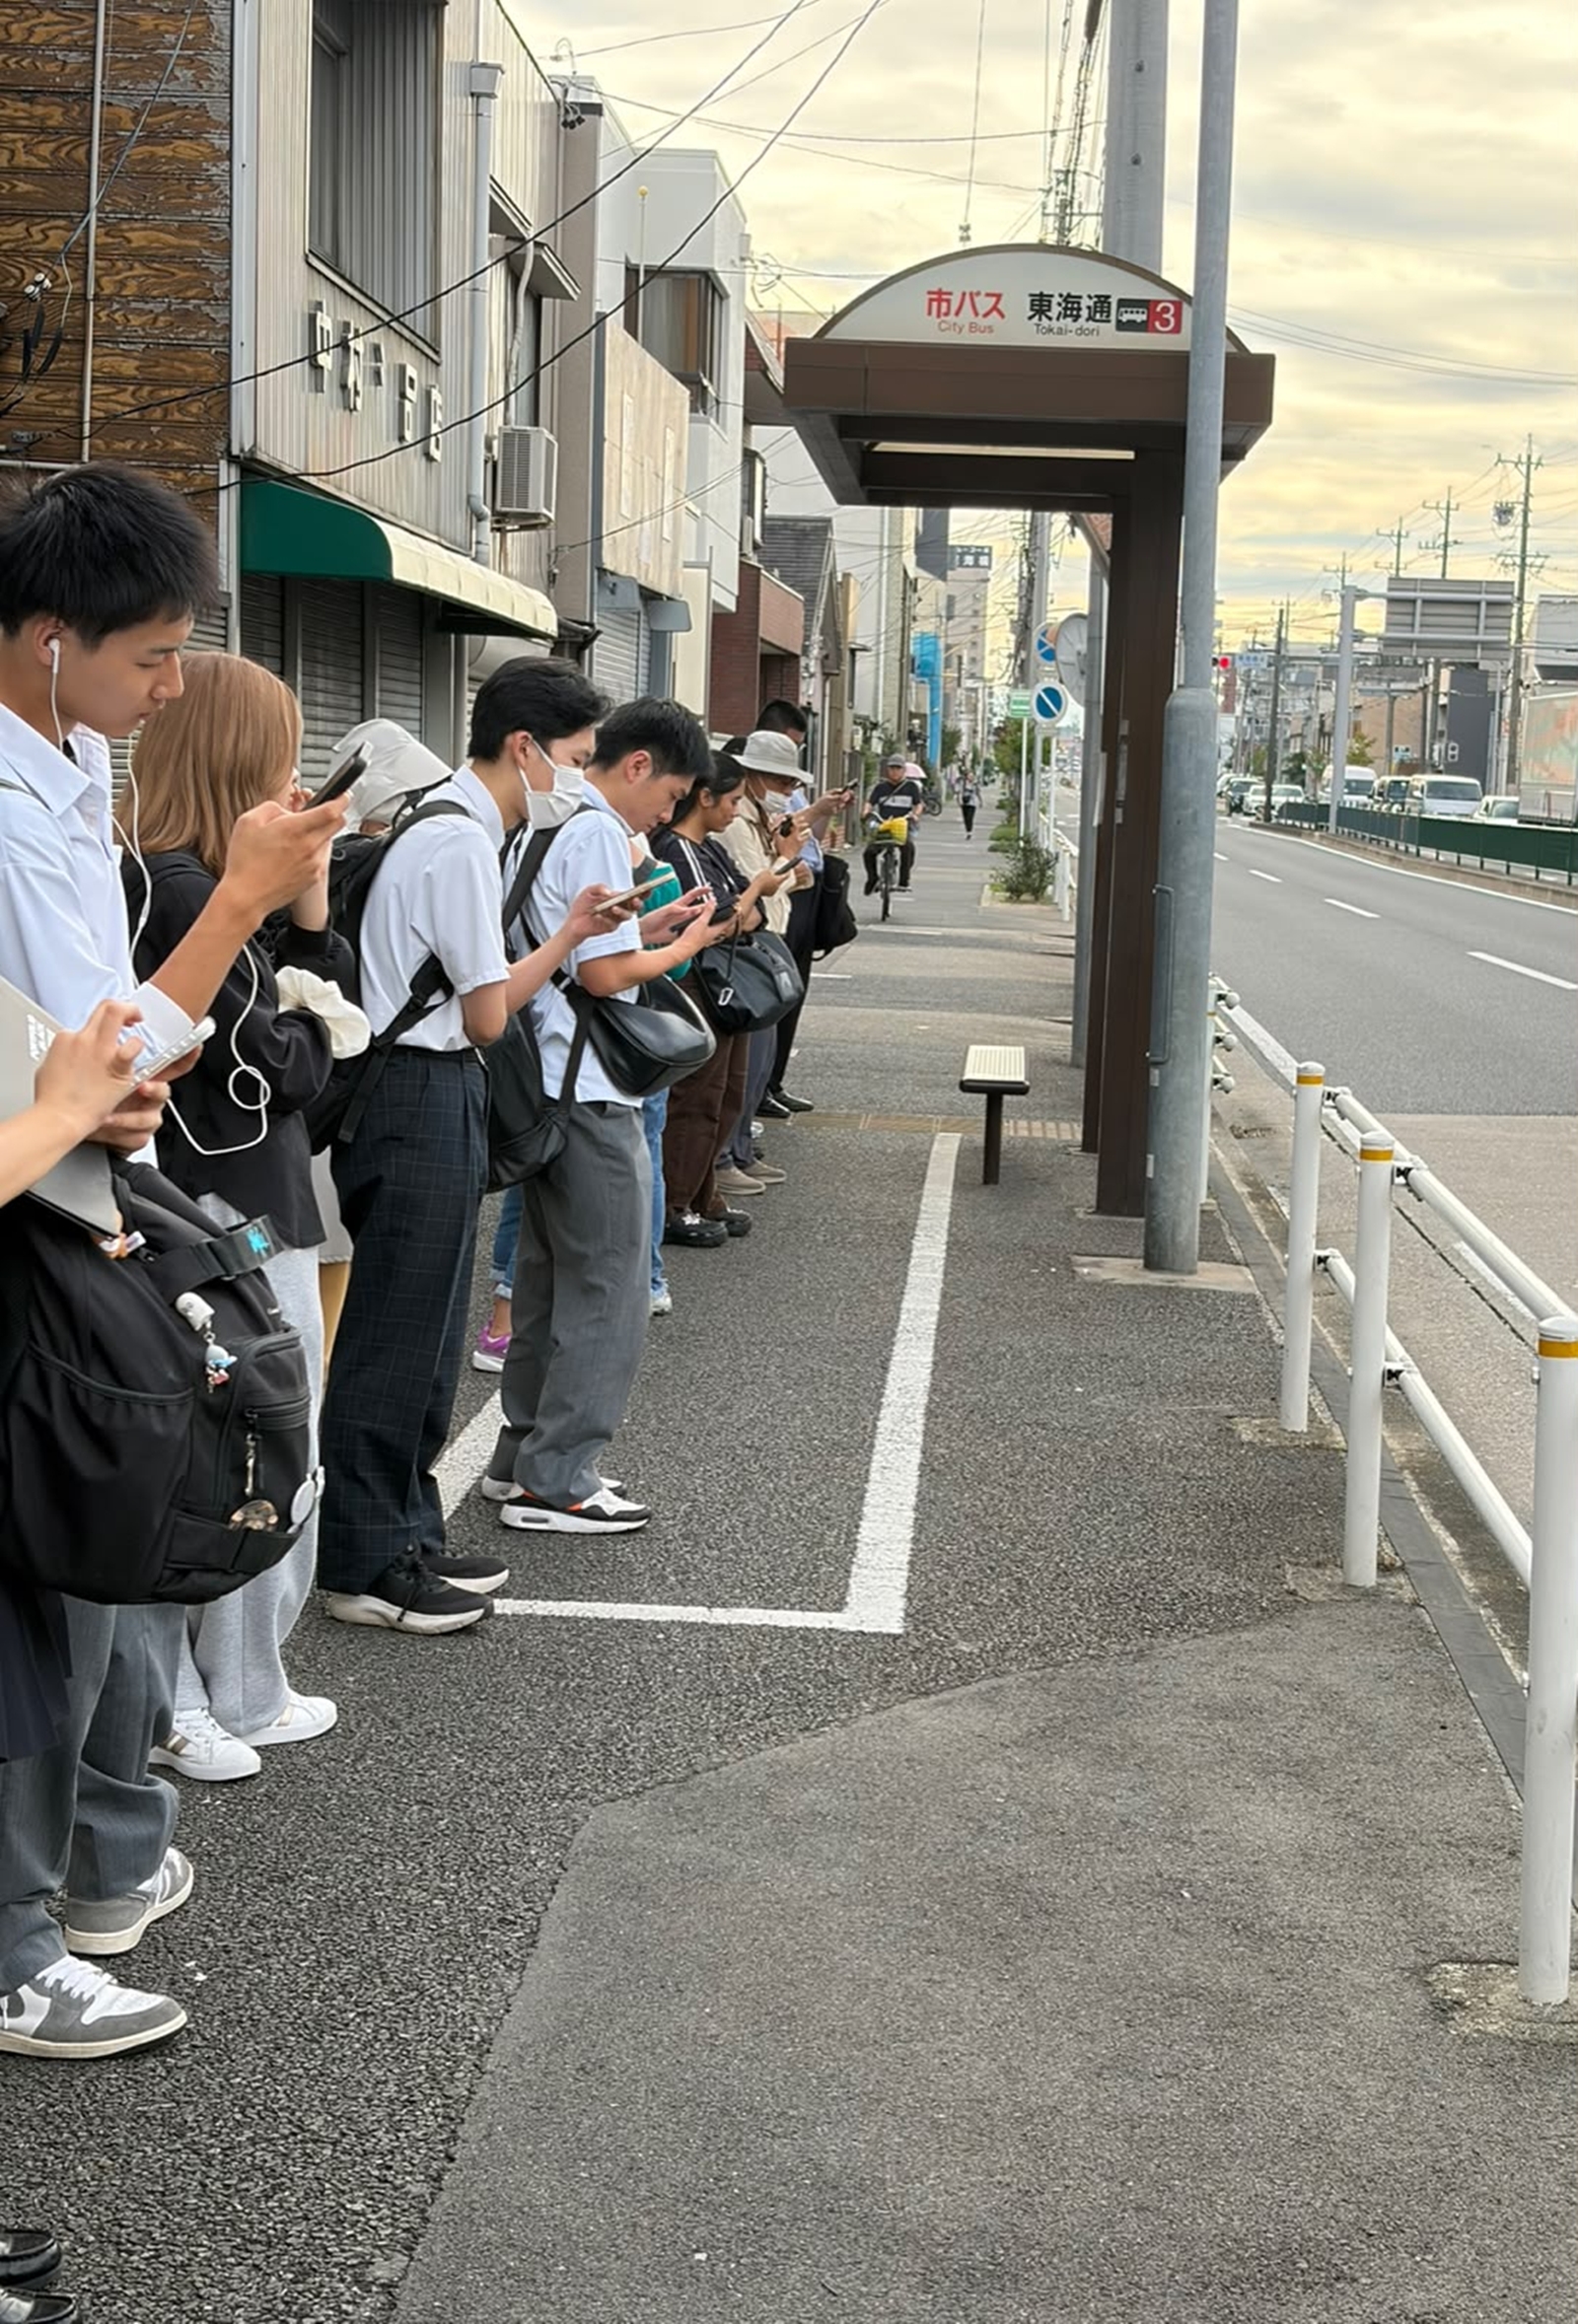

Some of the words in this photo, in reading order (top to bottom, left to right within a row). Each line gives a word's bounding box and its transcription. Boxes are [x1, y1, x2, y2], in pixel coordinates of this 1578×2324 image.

[926, 288, 1006, 319] 市バス
[1028, 291, 1112, 323] 東海通
[1154, 302, 1176, 331] 3
[938, 320, 964, 334] City
[968, 321, 994, 334] Bus
[1034, 323, 1100, 337] Tokai-dori
